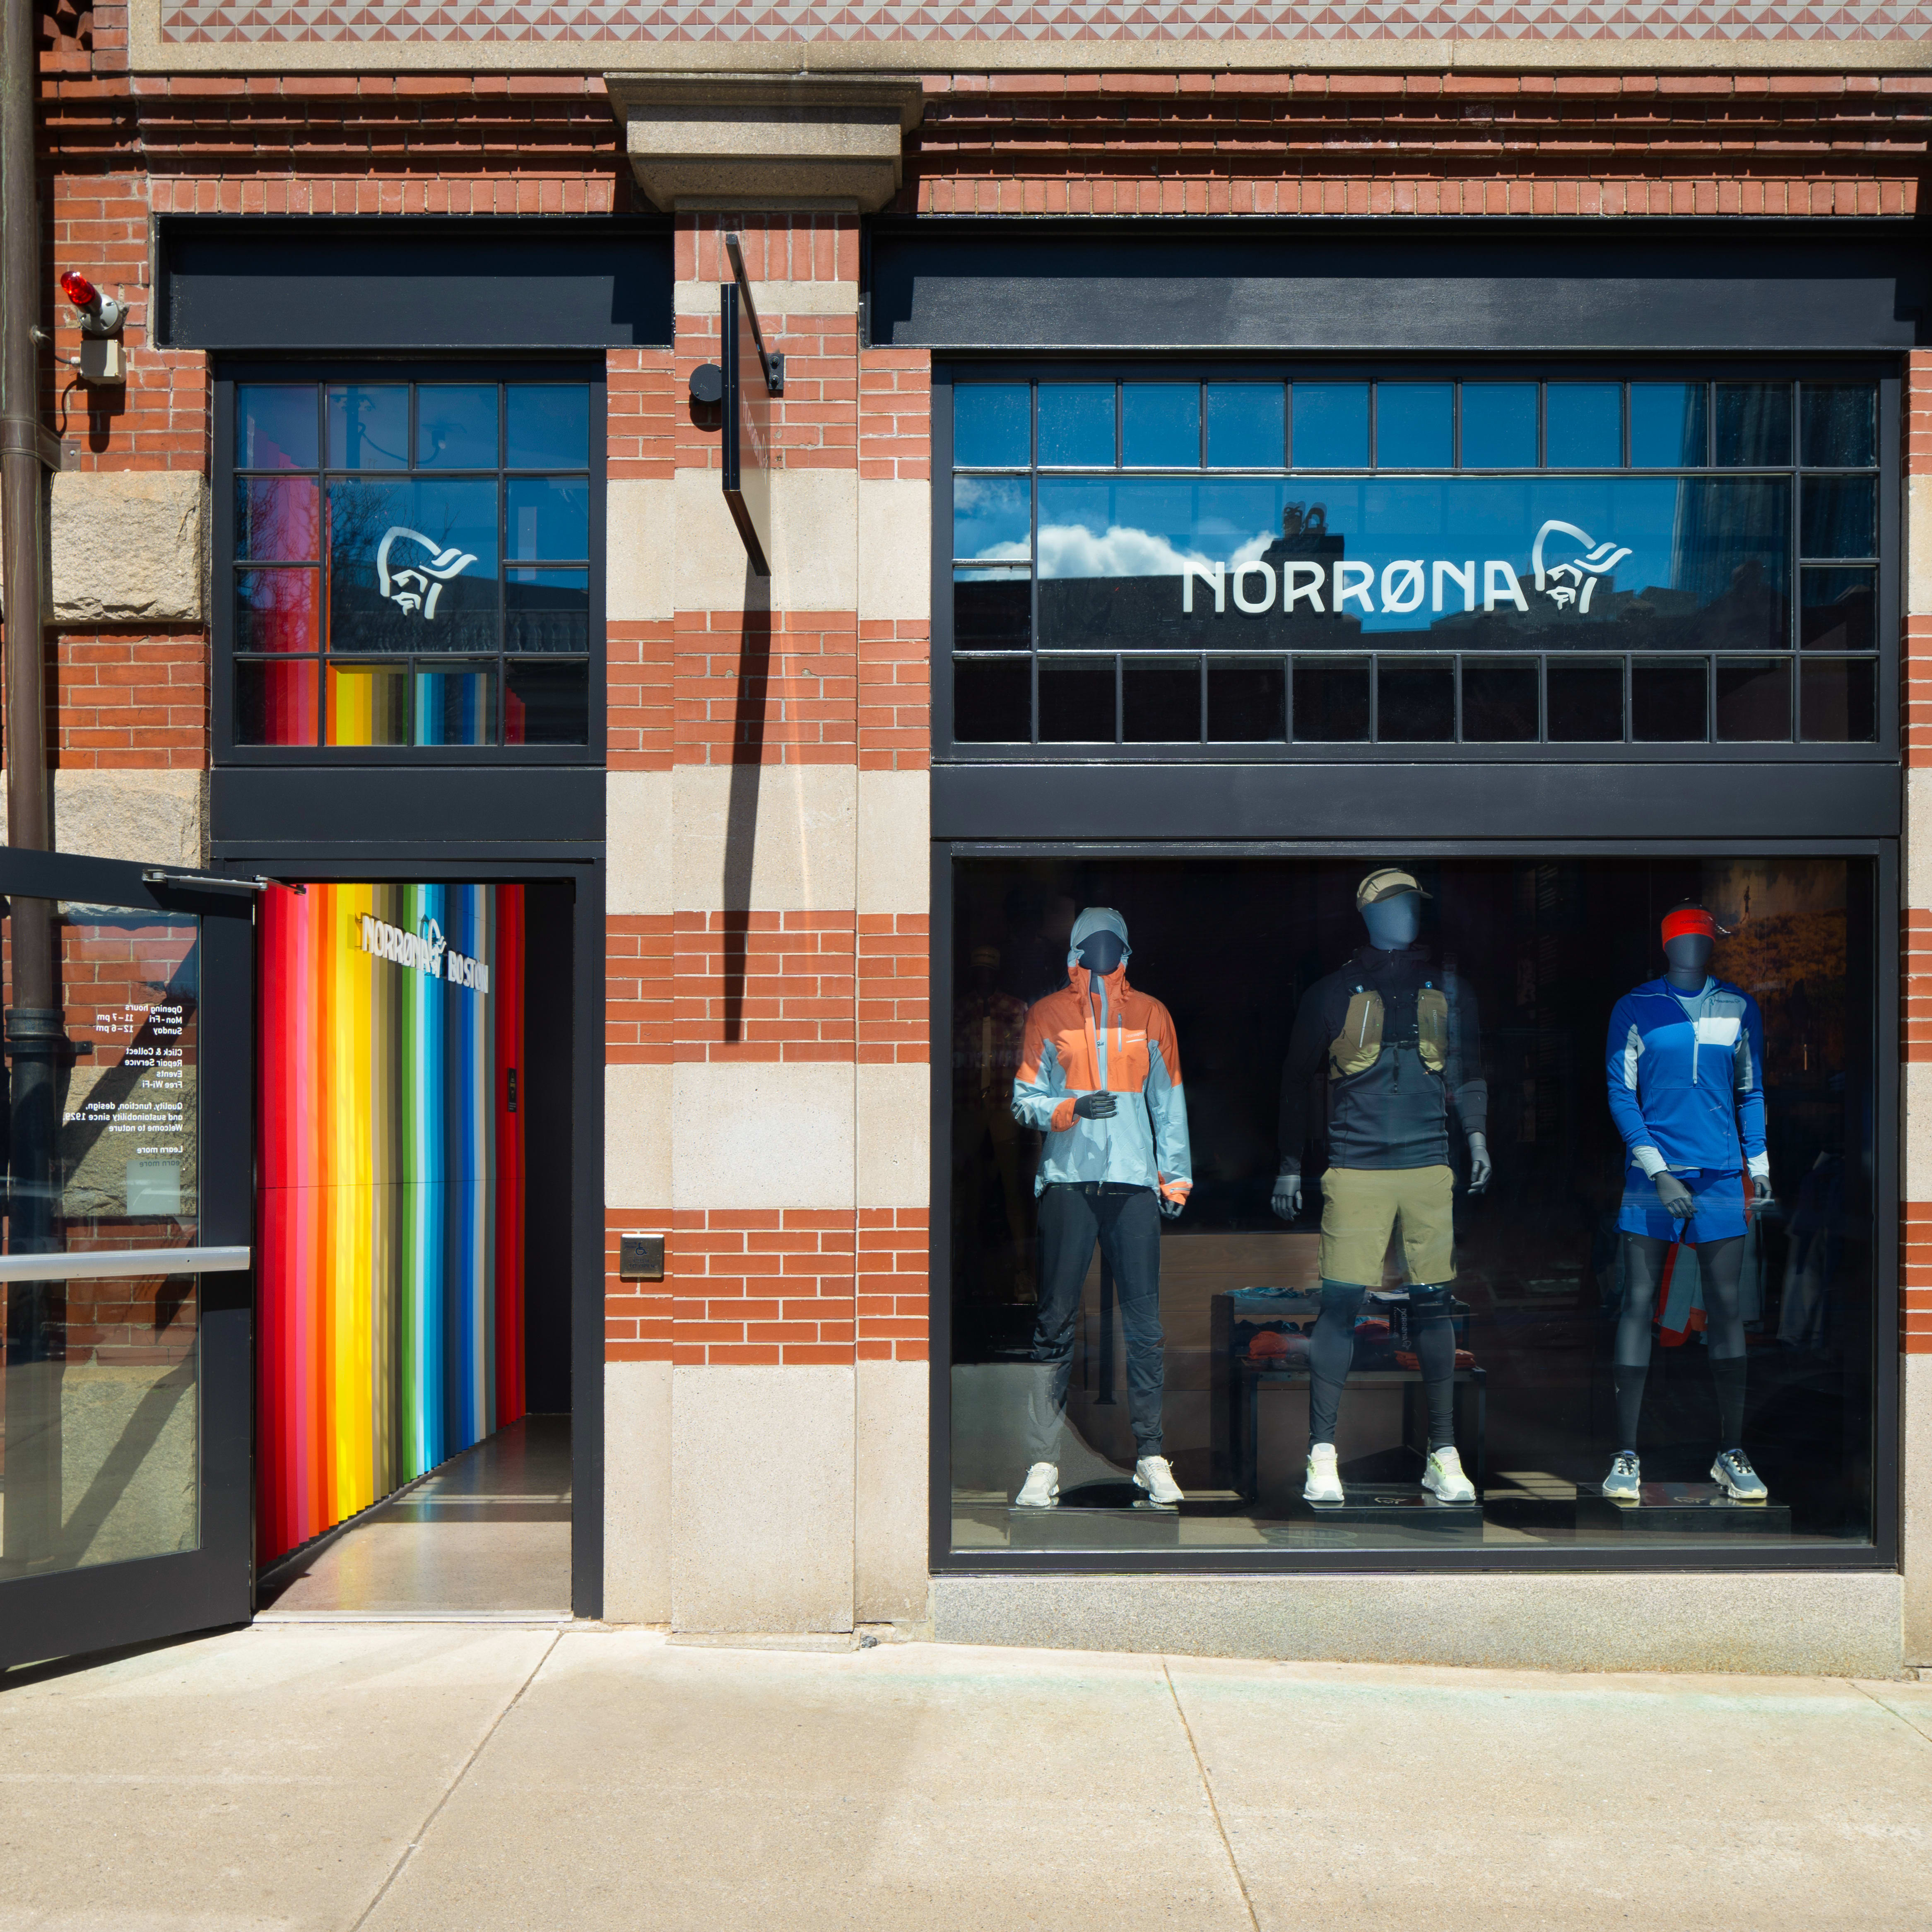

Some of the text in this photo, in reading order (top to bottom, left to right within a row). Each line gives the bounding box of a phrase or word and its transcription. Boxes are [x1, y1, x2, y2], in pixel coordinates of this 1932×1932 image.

[1183, 560, 1528, 614] NORRØNA
[362, 915, 489, 993] NORRØNA BOSTON
